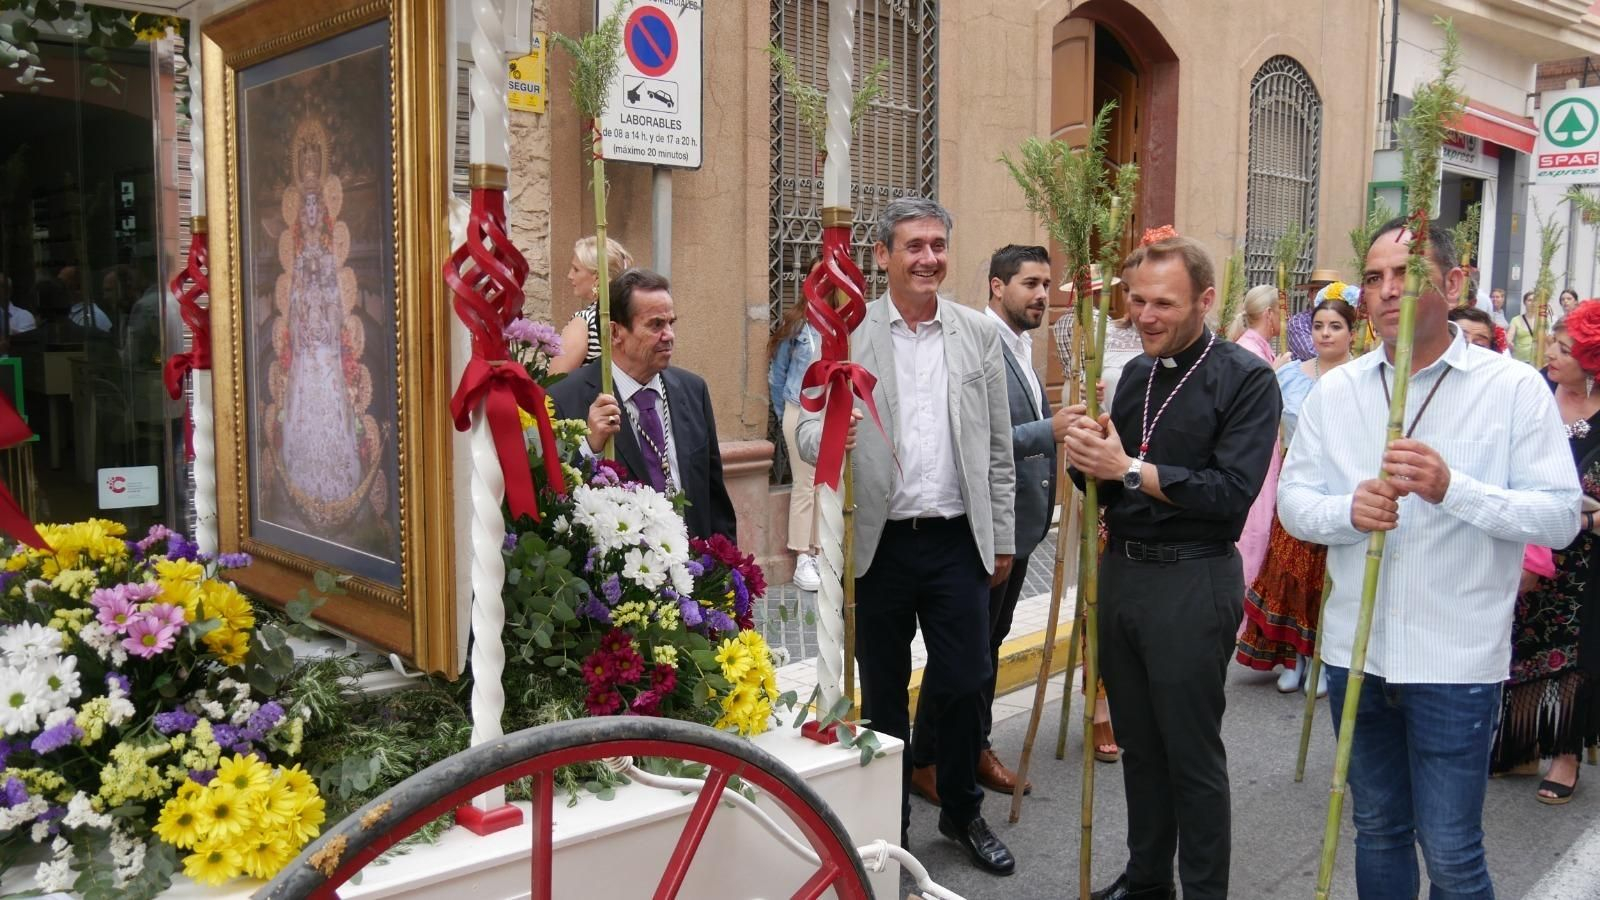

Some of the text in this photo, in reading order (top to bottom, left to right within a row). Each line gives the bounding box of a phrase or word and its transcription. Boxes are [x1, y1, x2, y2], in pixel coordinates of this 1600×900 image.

[620, 113, 681, 130] LABORABLES
[602, 127, 698, 147] de 08 a 14 h. y de 17 a 20 h.
[613, 144, 689, 161] (máximo 20 minutos)
[1540, 153, 1597, 166] SPAR
[1537, 168, 1599, 178] express
